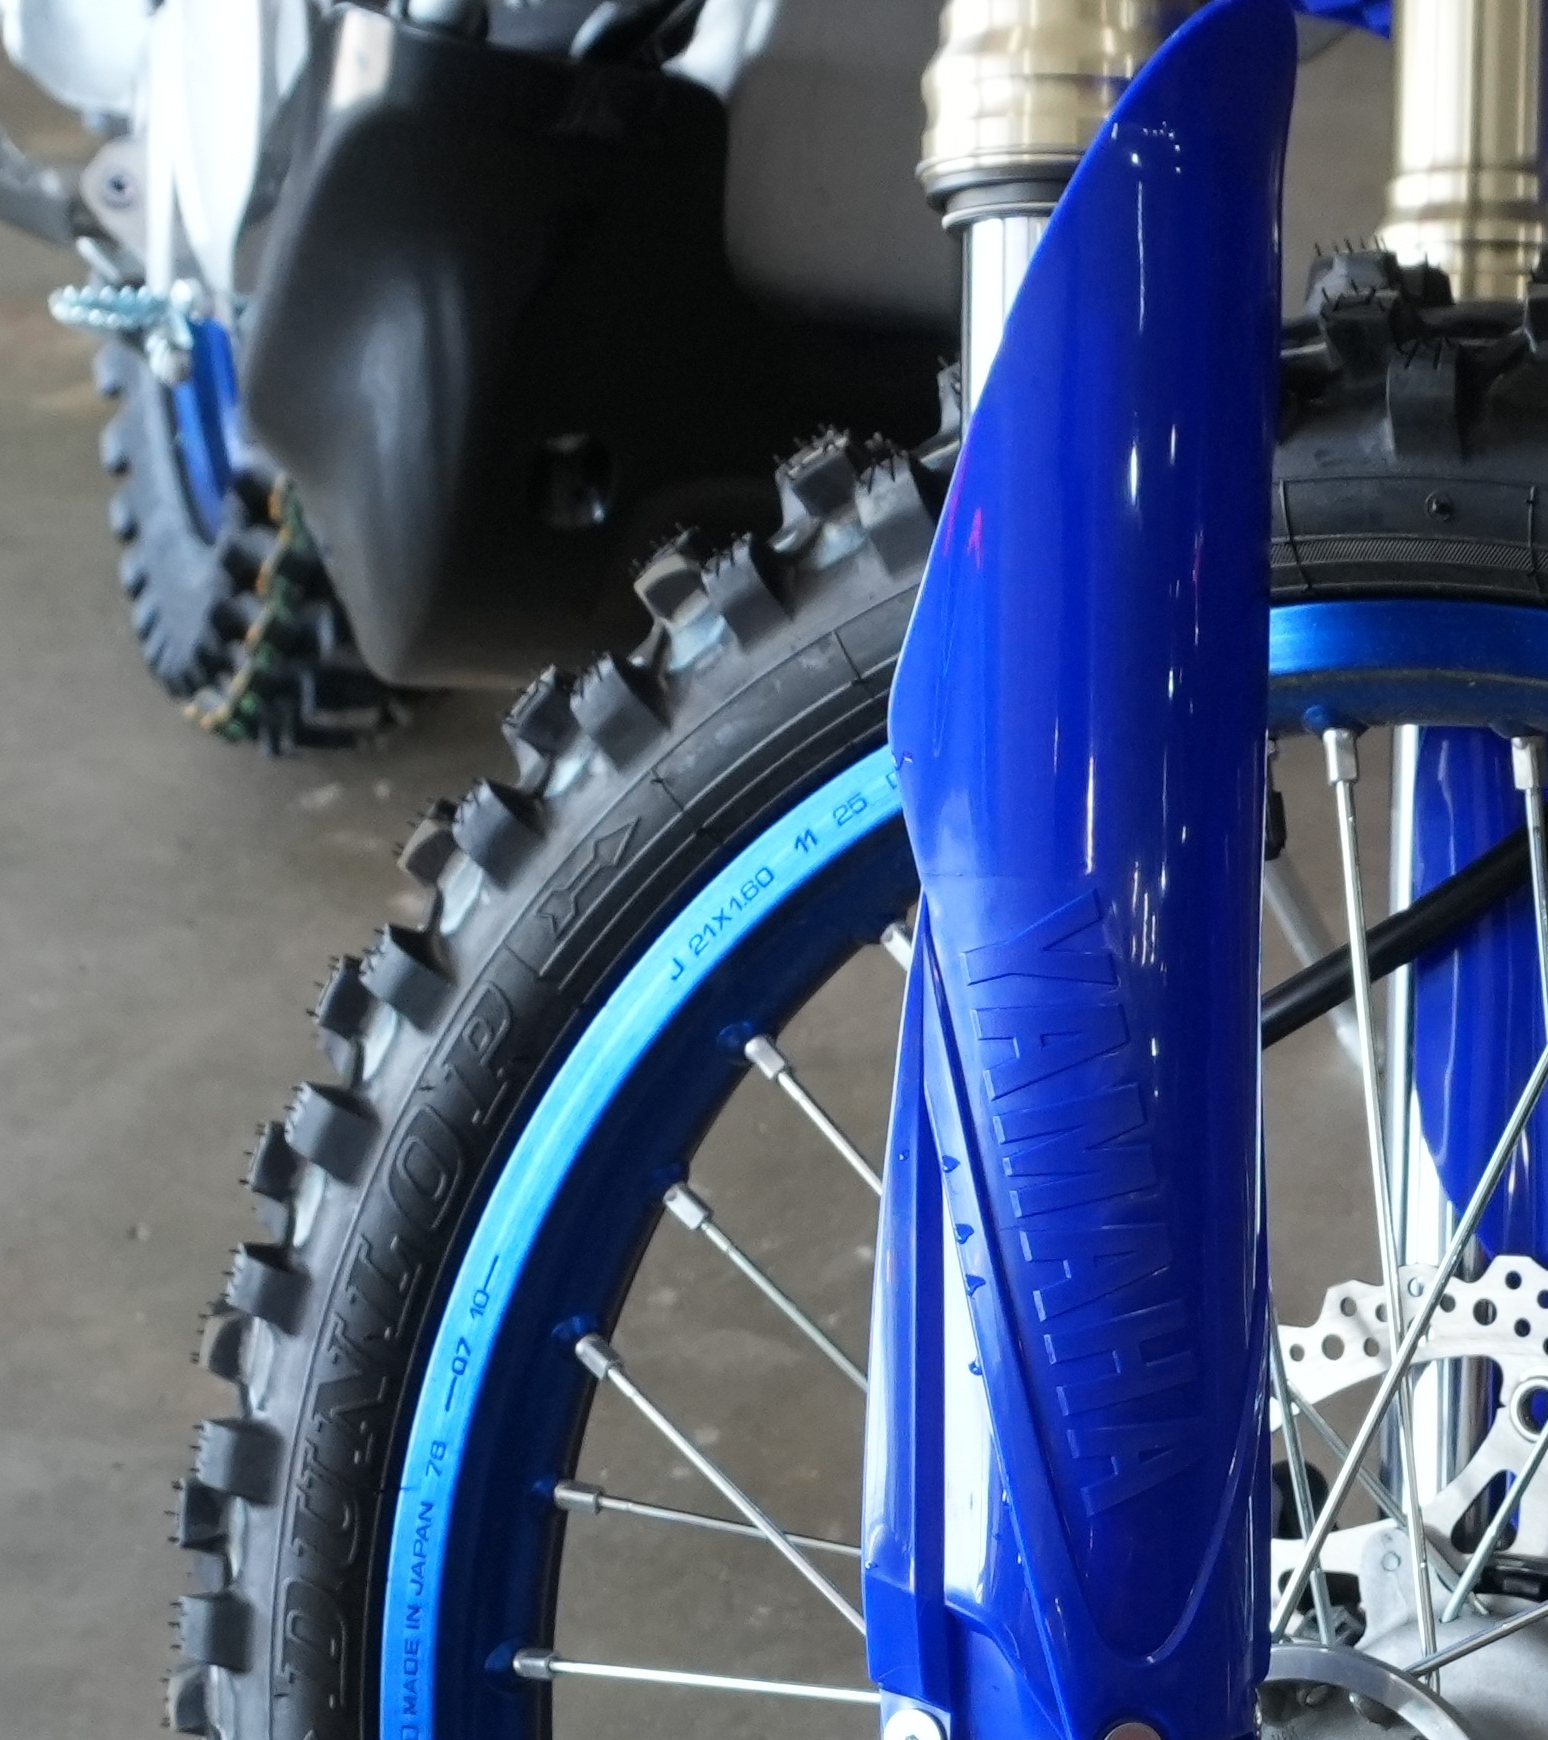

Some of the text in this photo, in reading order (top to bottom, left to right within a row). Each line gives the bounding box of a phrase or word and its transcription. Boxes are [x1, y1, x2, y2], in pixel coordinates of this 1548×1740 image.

[670, 792, 869, 981] J 21X1.60 11 25
[960, 888, 1205, 1517] YAMAHA
[272, 980, 513, 1710] DUNLOP
[405, 1604, 422, 1630] IN
[410, 1500, 435, 1597] JAPAN
[402, 1637, 420, 1716] MADE
